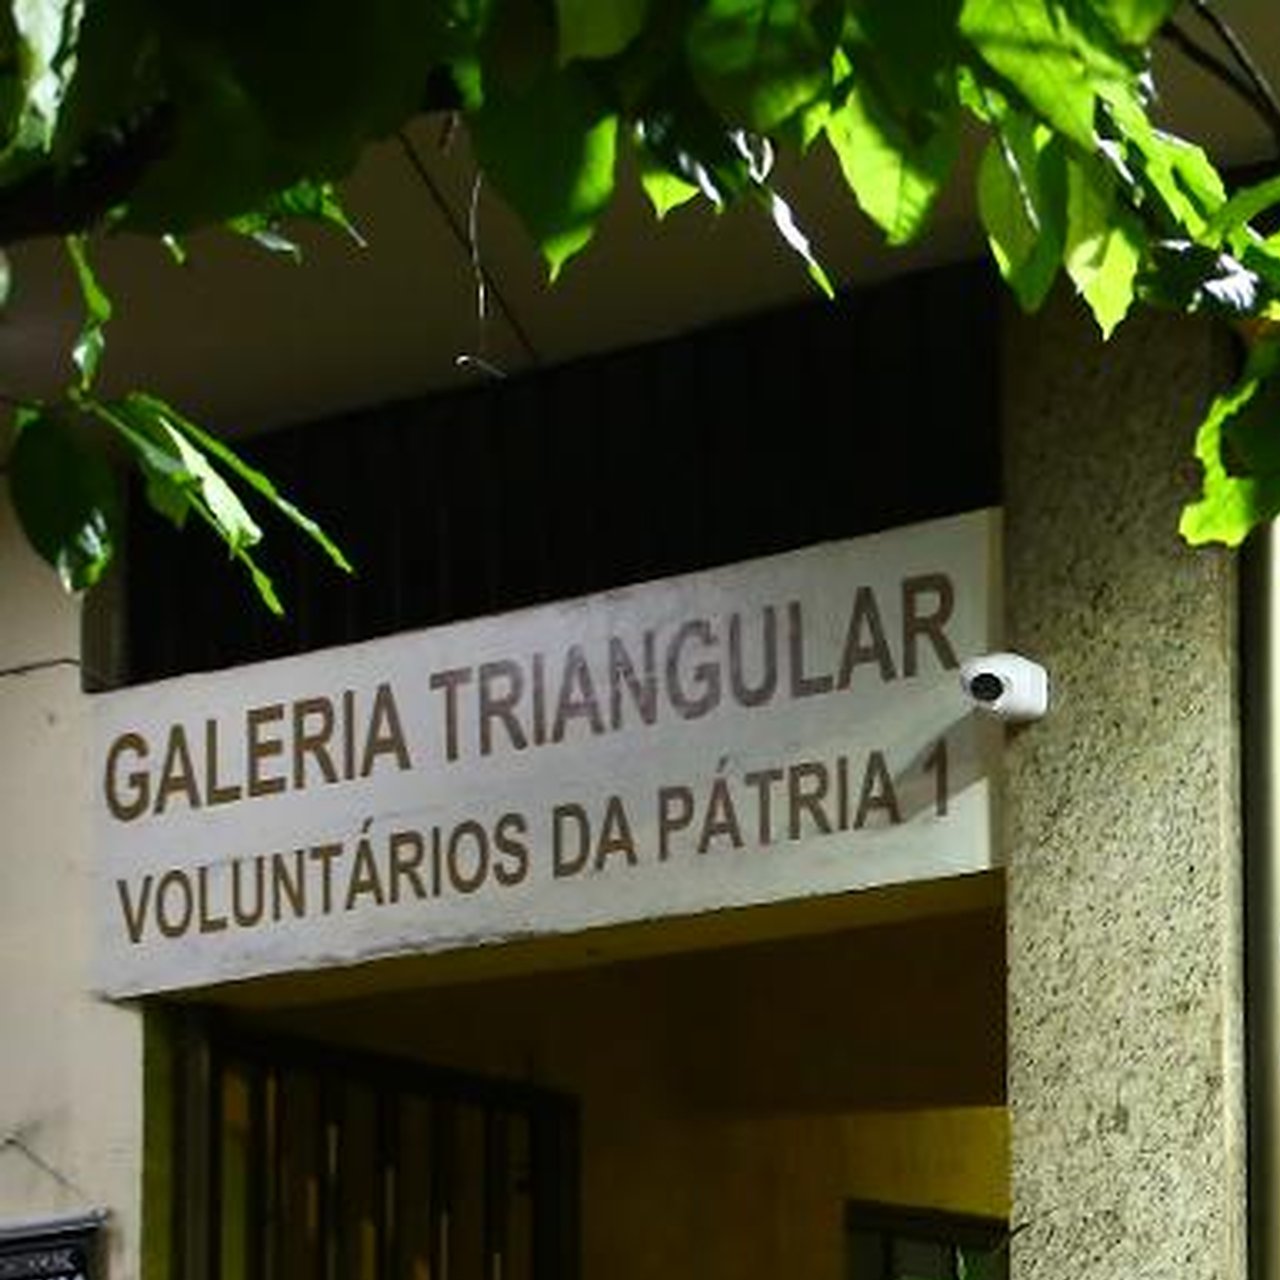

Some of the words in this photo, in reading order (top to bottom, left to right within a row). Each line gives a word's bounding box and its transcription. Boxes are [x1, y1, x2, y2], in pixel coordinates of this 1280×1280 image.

[104, 682, 412, 822] GALERIA
[429, 572, 960, 763] TRIANGULAR
[116, 812, 529, 944] VOLUNTÁRIOS
[551, 796, 638, 880] DA
[656, 756, 902, 862] PÁTRIA
[923, 739, 950, 818] 1
